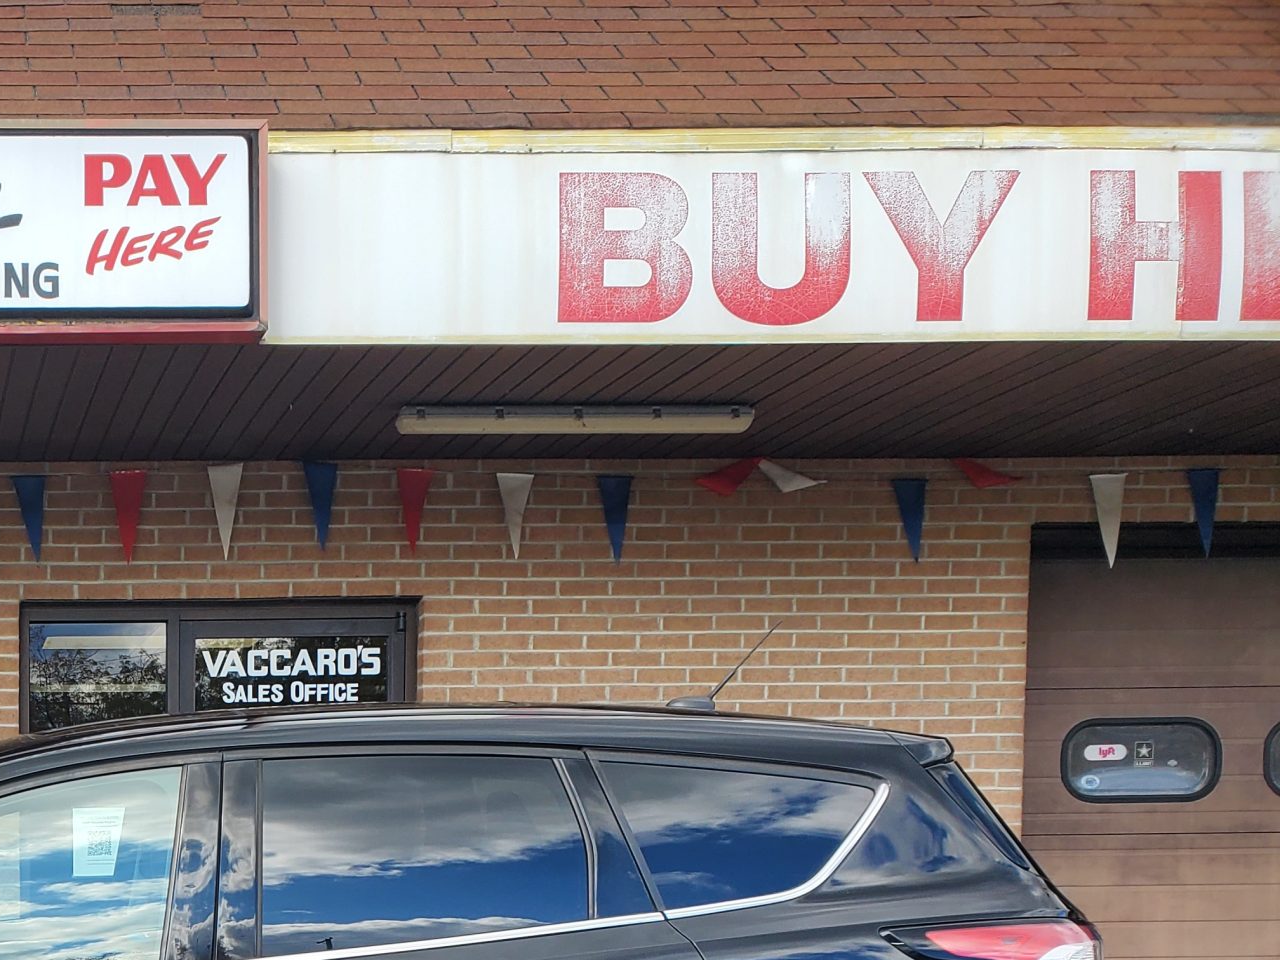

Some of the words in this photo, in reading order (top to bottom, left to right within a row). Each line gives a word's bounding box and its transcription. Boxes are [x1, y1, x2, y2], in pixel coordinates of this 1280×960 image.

[83, 153, 228, 207] PAY
[85, 216, 222, 276] HERE
[556, 169, 1021, 326] BUY
[201, 645, 382, 678] VACCARO'S
[222, 681, 284, 704] SALES
[290, 680, 359, 703] OFFICE
[1098, 746, 1116, 758] lyft
